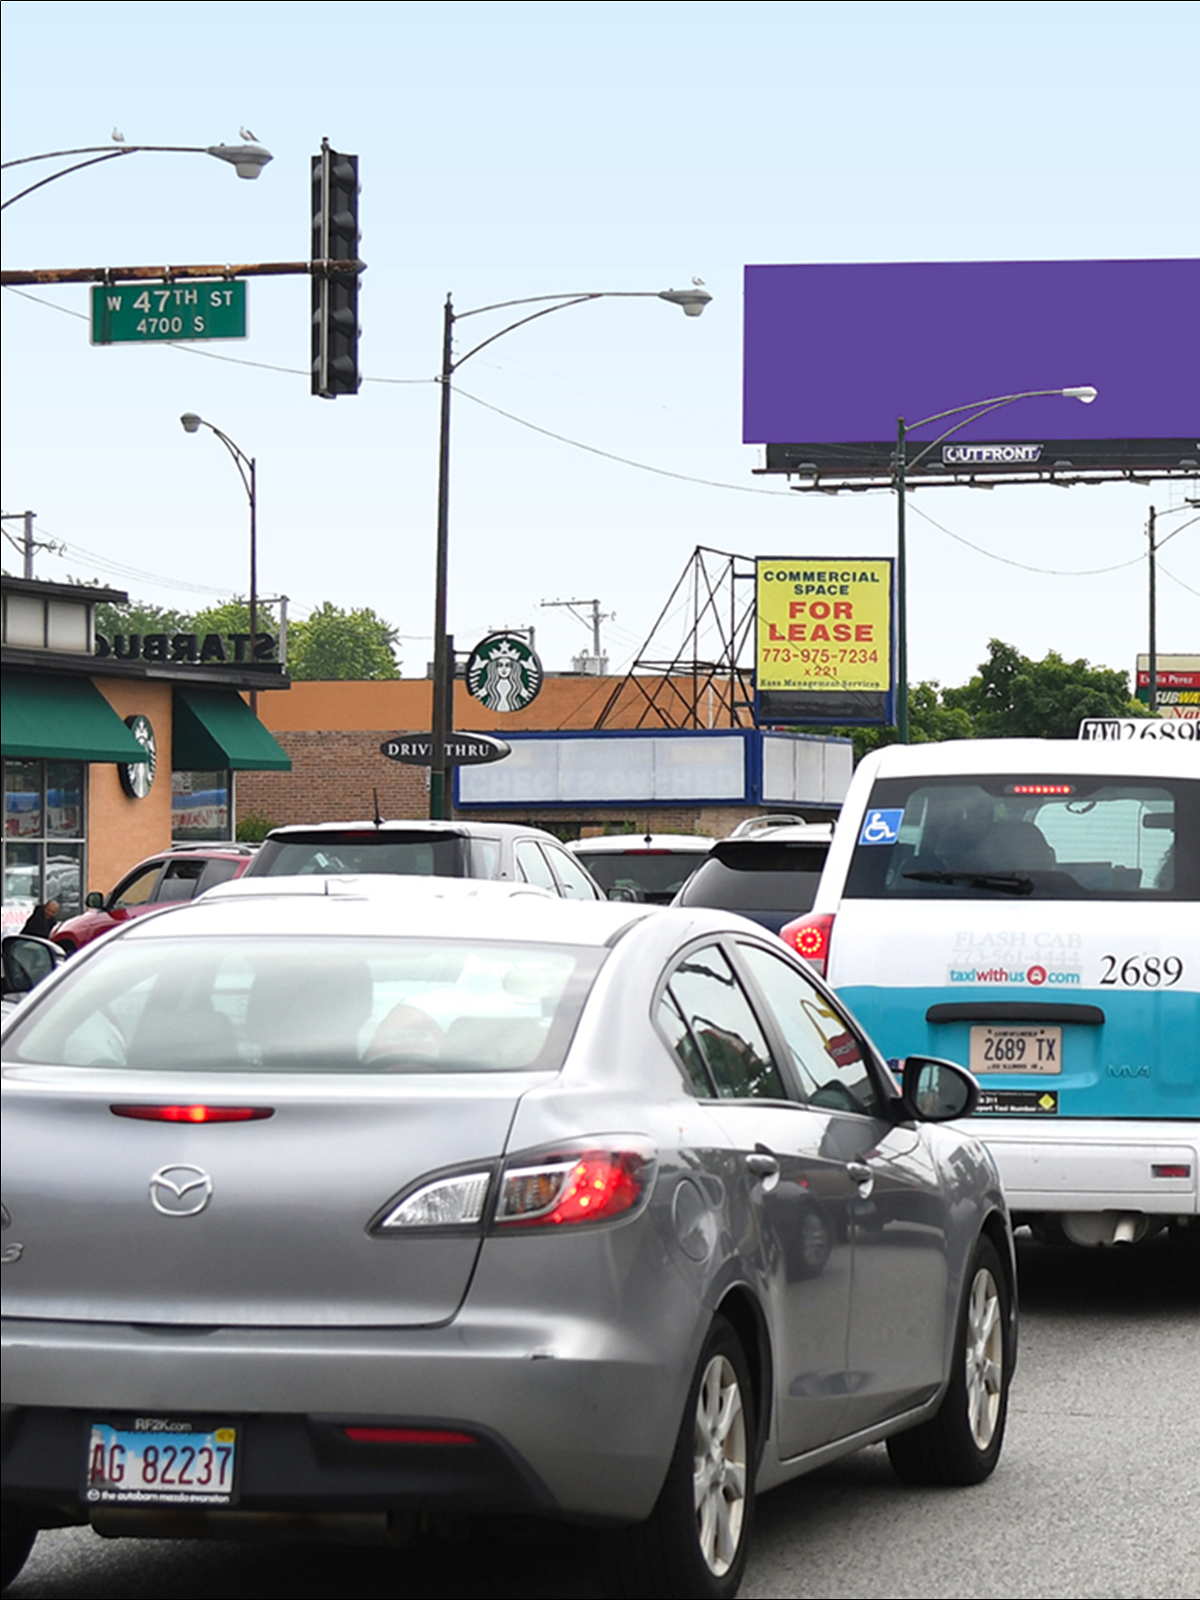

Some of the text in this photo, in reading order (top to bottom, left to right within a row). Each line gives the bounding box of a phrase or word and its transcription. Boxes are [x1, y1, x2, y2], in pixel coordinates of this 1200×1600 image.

[107, 289, 233, 313] W 47TH ST
[136, 316, 205, 334] 4700 S
[946, 446, 1037, 461] OUTFRONT
[763, 571, 880, 582] COMMERCIAL
[794, 584, 850, 595] SPACE
[789, 601, 853, 620] FOR
[769, 623, 874, 642] LEASE
[762, 648, 879, 663] 773-975-7234
[814, 666, 838, 676] 221
[444, 744, 489, 756] THRU
[1100, 955, 1183, 987] 2689
[984, 1038, 1056, 1061] 2689 TX
[135, 1419, 191, 1430] RF2K.com
[91, 1443, 232, 1485] AG 82237
